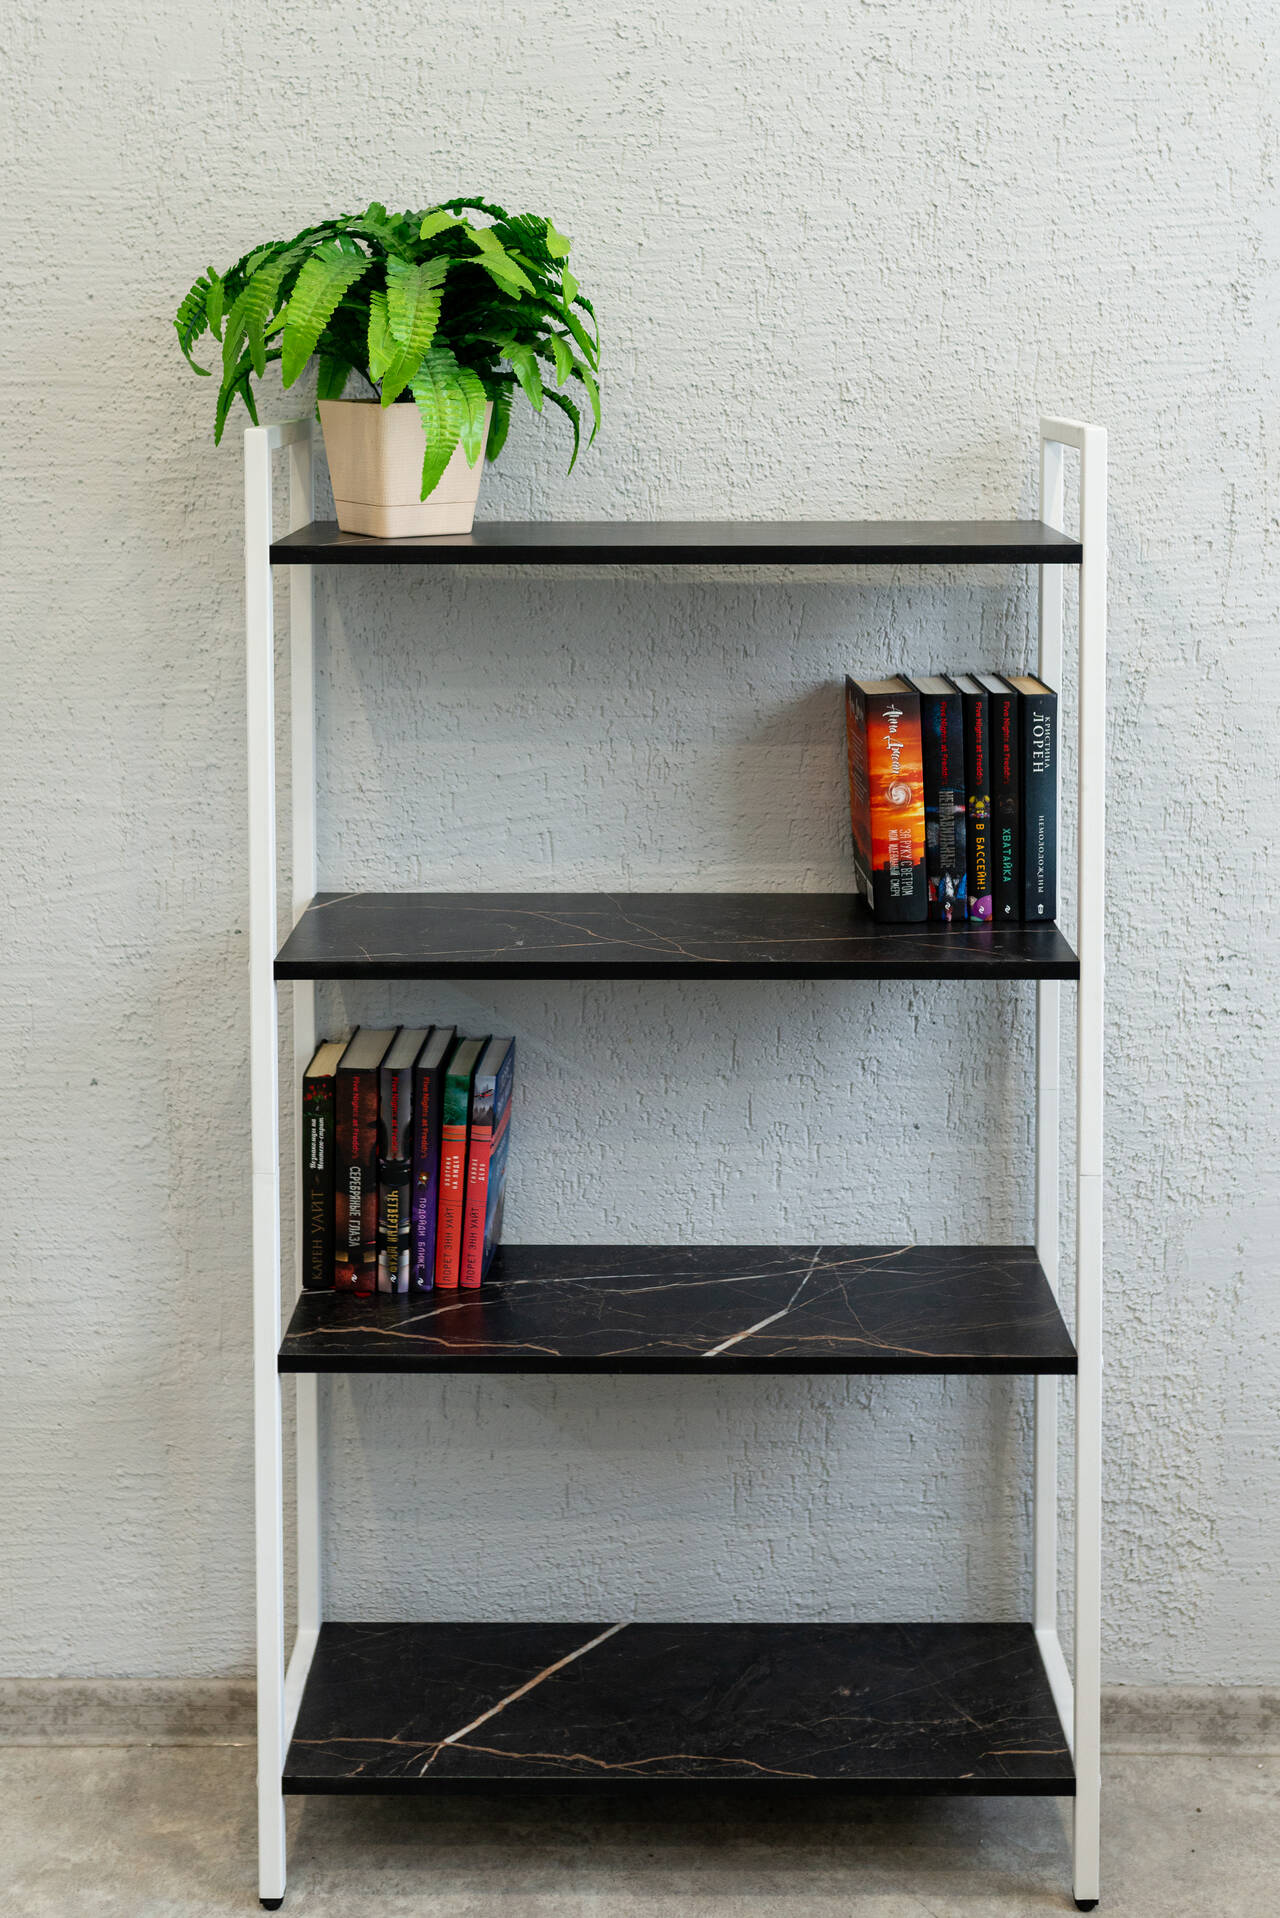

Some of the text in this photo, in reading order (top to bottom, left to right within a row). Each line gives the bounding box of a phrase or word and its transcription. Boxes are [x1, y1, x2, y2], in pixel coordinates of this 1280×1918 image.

[975, 701, 983, 717] Five
[1032, 711, 1044, 773] ЛОРЕН
[899, 829, 911, 839] ЗА
[900, 840, 912, 859] РУКУ
[939, 791, 956, 869] НЕПРАВИЛЬНЫЕ
[1002, 828, 1013, 882] ХВАТАЙКА
[1037, 815, 1045, 893] НЕМОЛОДОЖЕНЫ
[901, 867, 914, 896] ВЕТРОМ
[976, 837, 987, 890] БАССЕЙН!
[352, 1076, 360, 1092] Five
[311, 1189, 324, 1280] КАРЕН УАЙТ
[348, 1166, 362, 1247] СЕРЕБРЯНЫЕ ГЛАЗА
[417, 1197, 428, 1269] ПОДОЙДИ БЛИЖЕ
[442, 1207, 455, 1282] ЛОРЕТ ЭНН УАЙТ
[465, 1207, 479, 1282] ЛОРЕТ ЭНН УАЙТ
